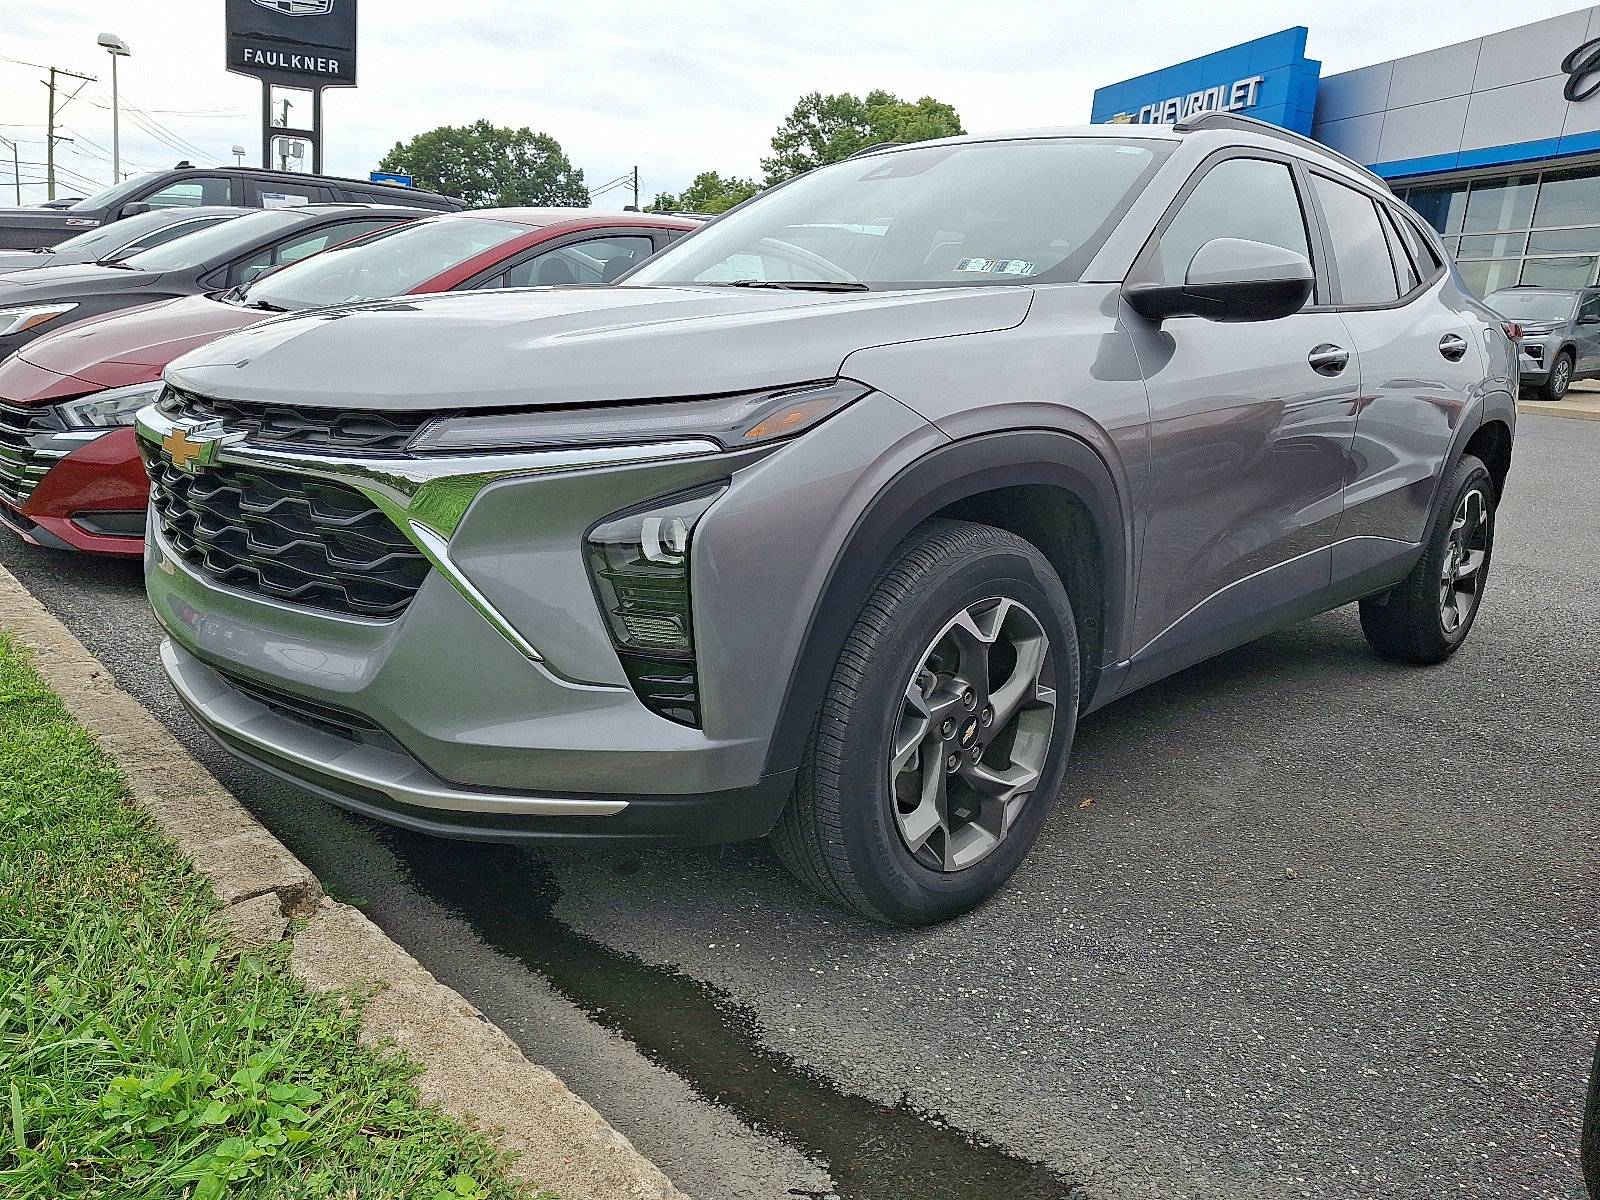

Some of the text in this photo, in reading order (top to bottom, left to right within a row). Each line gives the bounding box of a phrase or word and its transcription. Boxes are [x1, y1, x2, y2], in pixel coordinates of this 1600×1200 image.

[243, 48, 340, 74] FAULKNER
[1138, 75, 1264, 124] CHEVROLET
[980, 260, 995, 271] 27
[1020, 262, 1034, 274] 27
